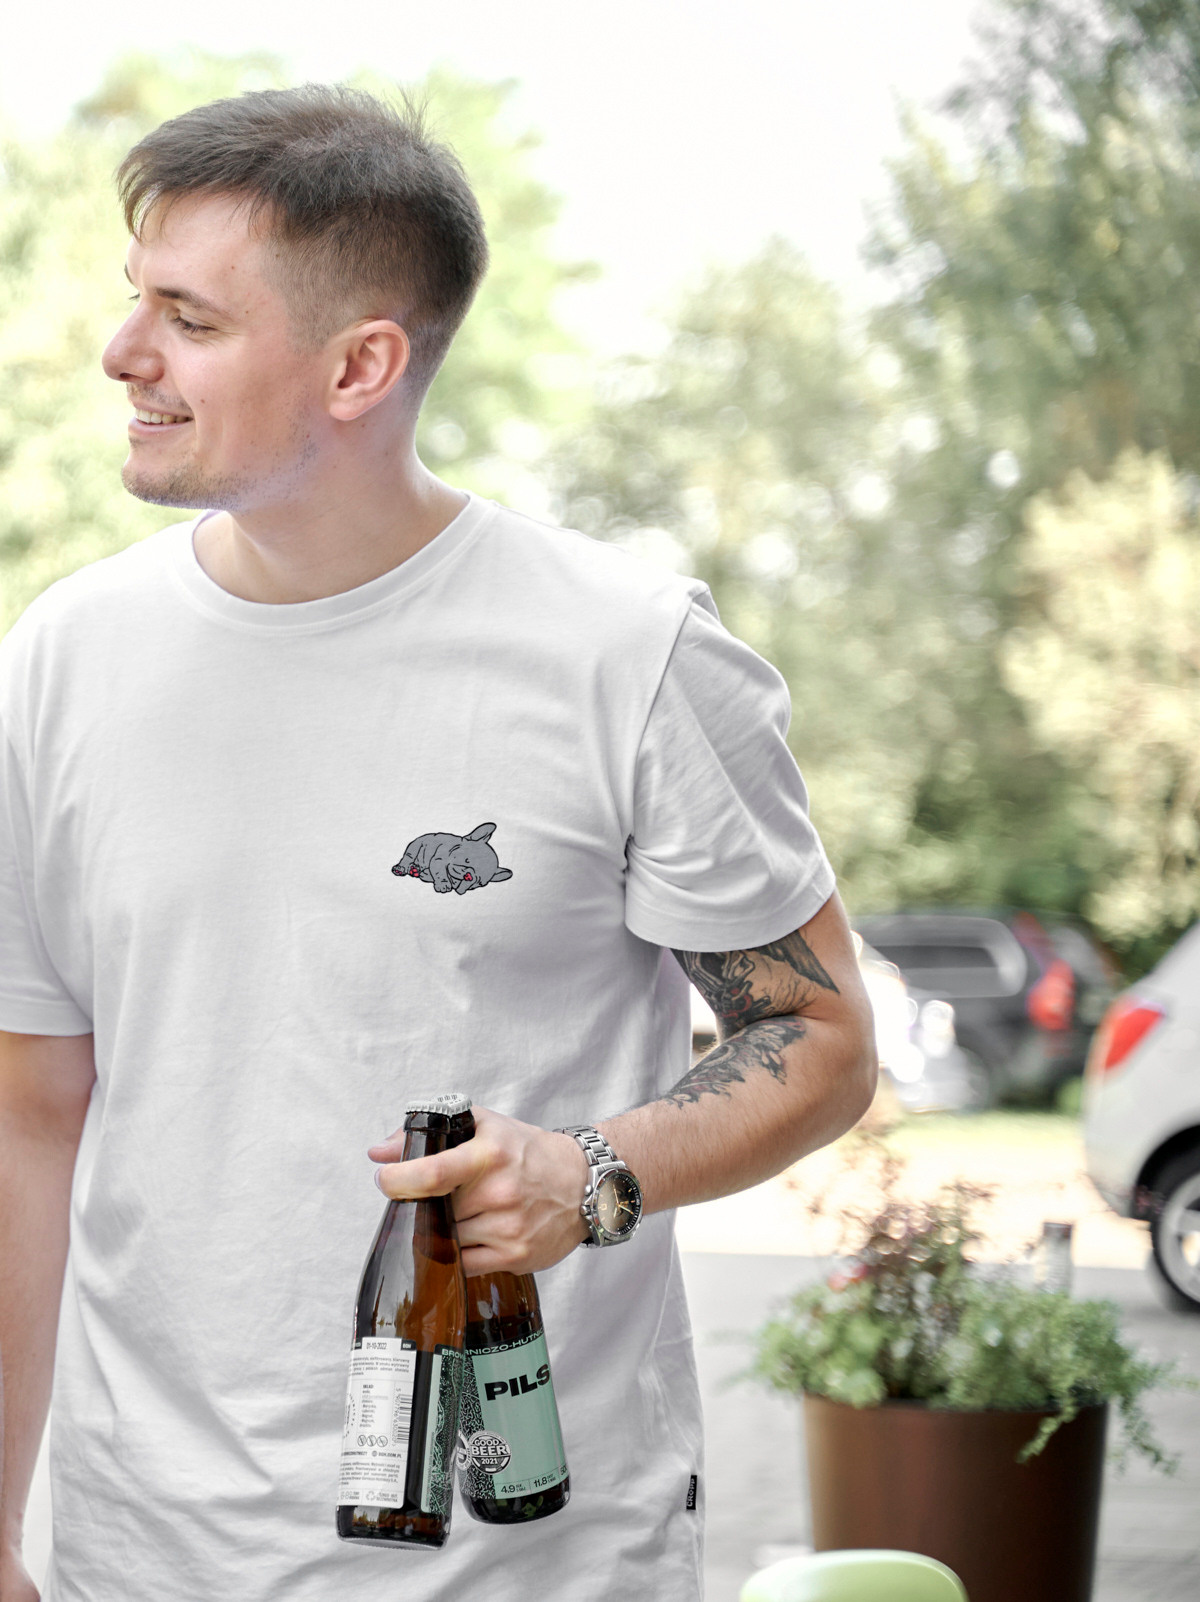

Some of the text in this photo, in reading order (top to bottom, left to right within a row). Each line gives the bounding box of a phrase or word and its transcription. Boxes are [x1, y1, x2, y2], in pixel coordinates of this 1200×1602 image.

[484, 1364, 550, 1401] PILS
[471, 1445, 507, 1456] BEER
[481, 1457, 498, 1465] 2021
[534, 1476, 547, 1487] 11.8
[501, 1485, 515, 1493] 4.9
